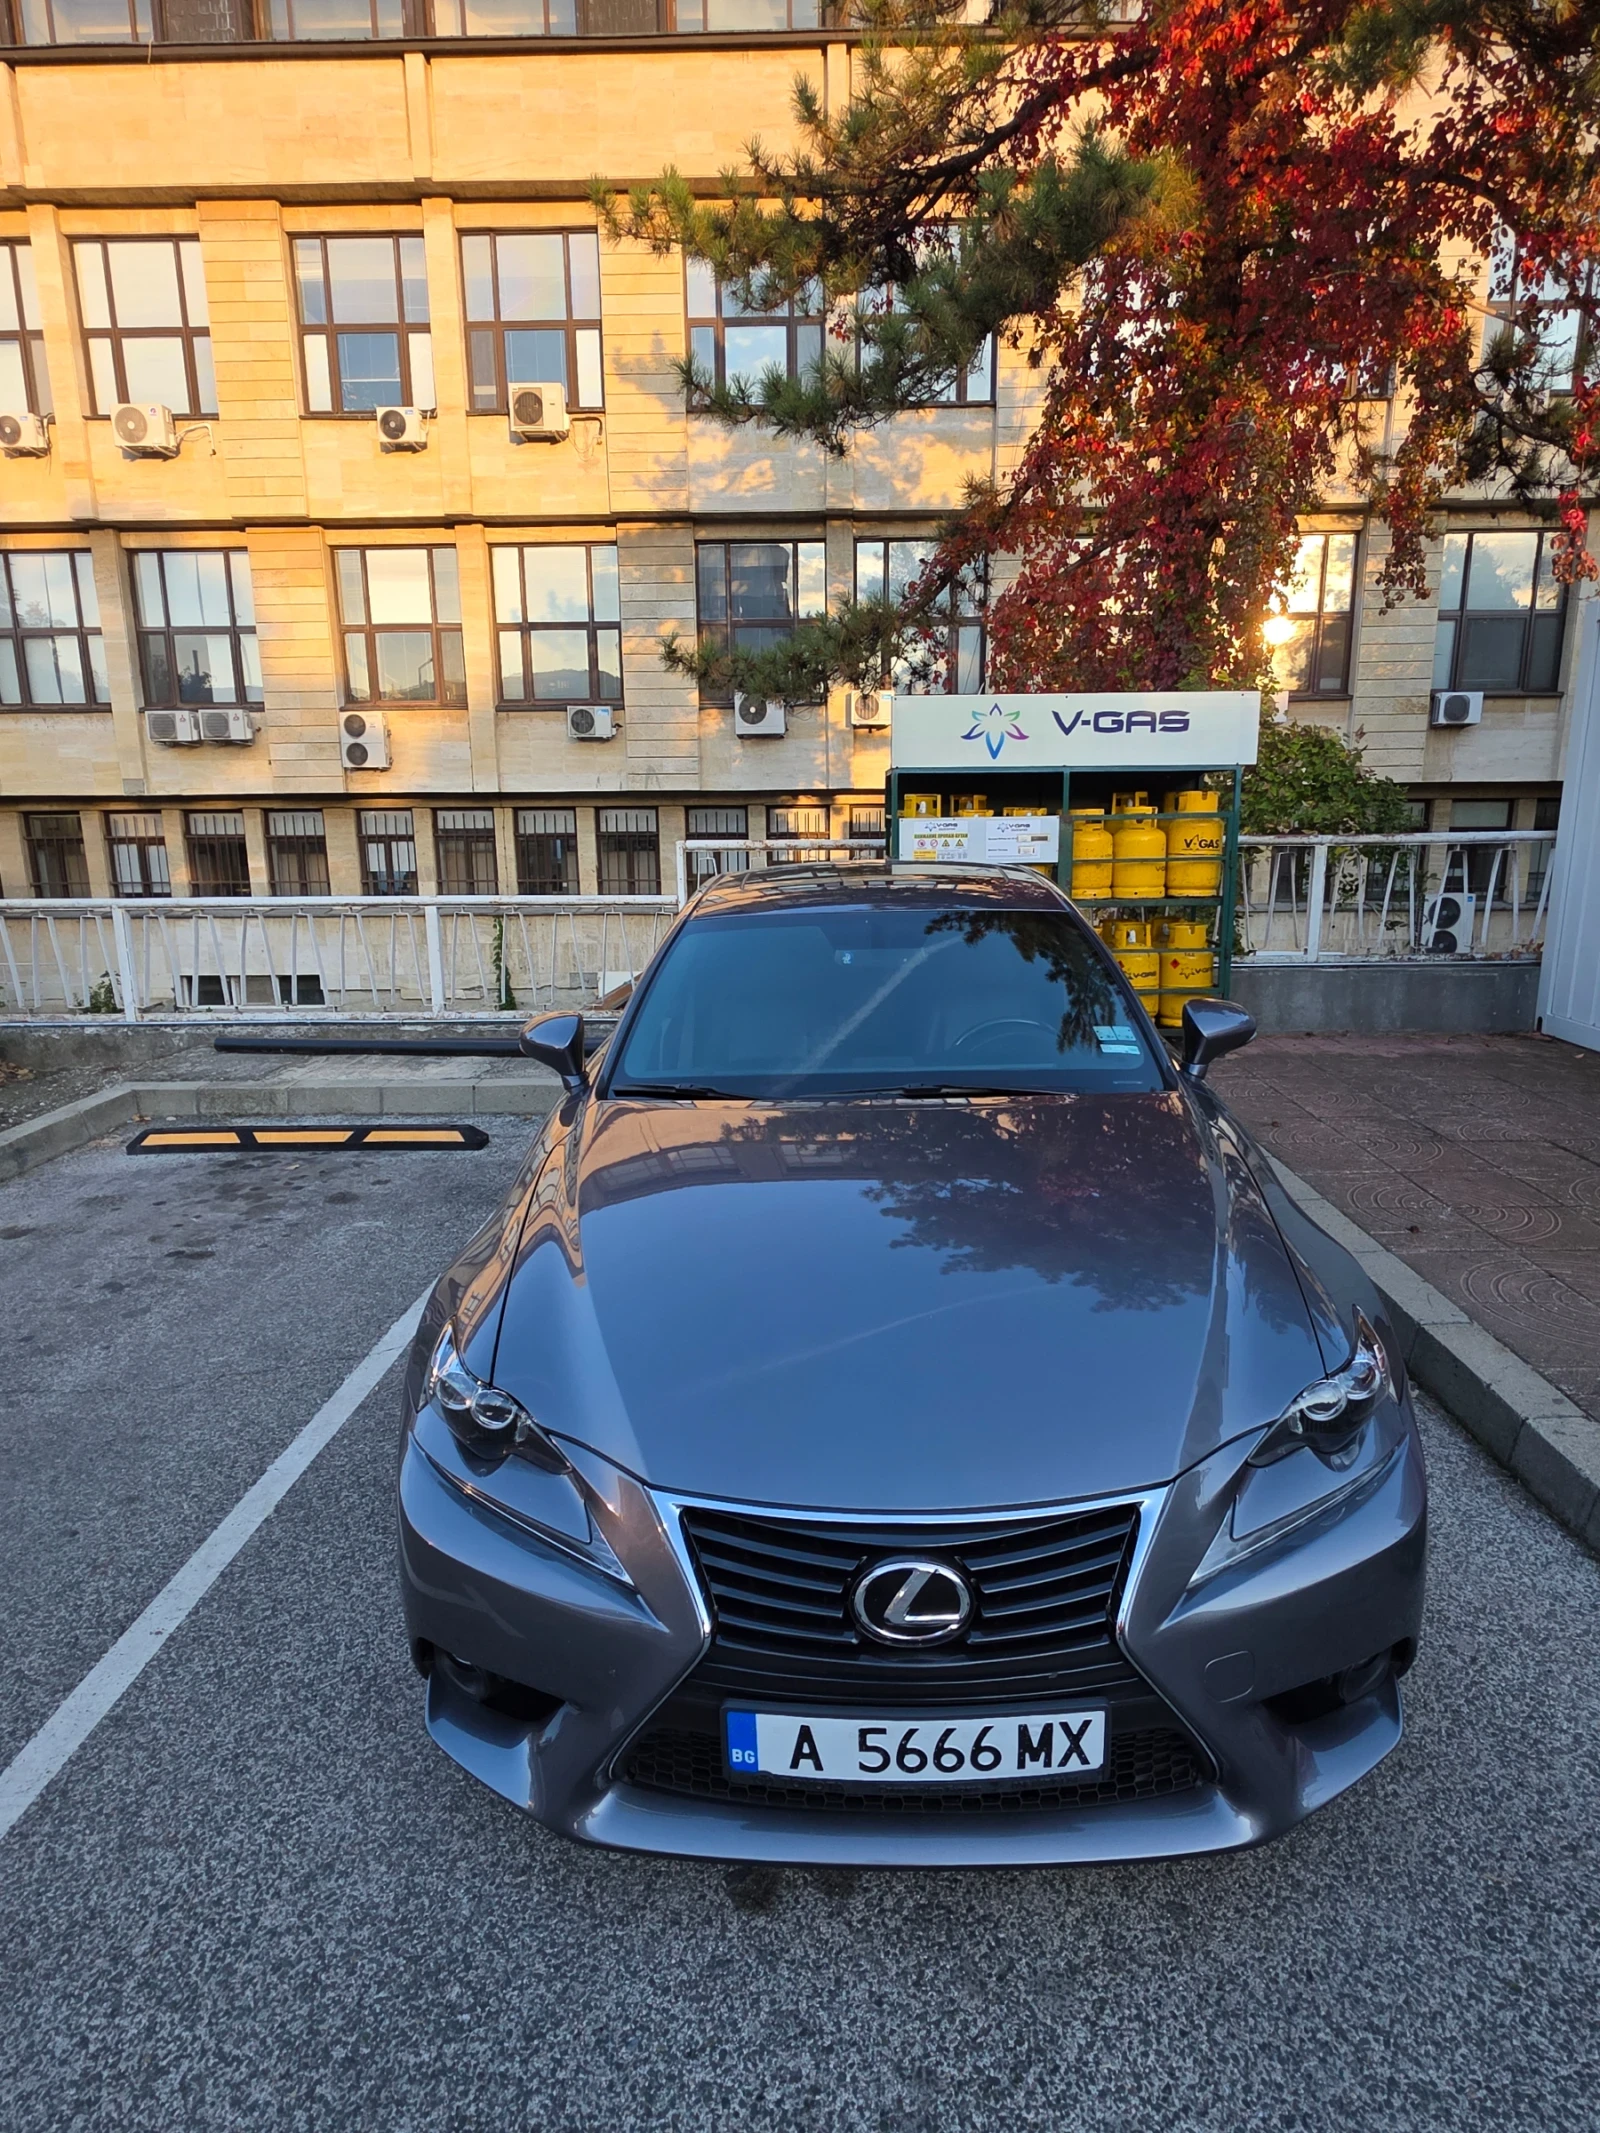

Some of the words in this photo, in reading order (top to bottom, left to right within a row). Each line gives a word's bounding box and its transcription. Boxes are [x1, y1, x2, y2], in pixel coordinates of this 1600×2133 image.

[1051, 709, 1190, 736] V-GAS
[1184, 838, 1220, 849] V-GAS
[731, 1748, 756, 1764] BG
[789, 1724, 824, 1771] A
[858, 1725, 1003, 1774] 5666
[1016, 1719, 1093, 1770] MX
